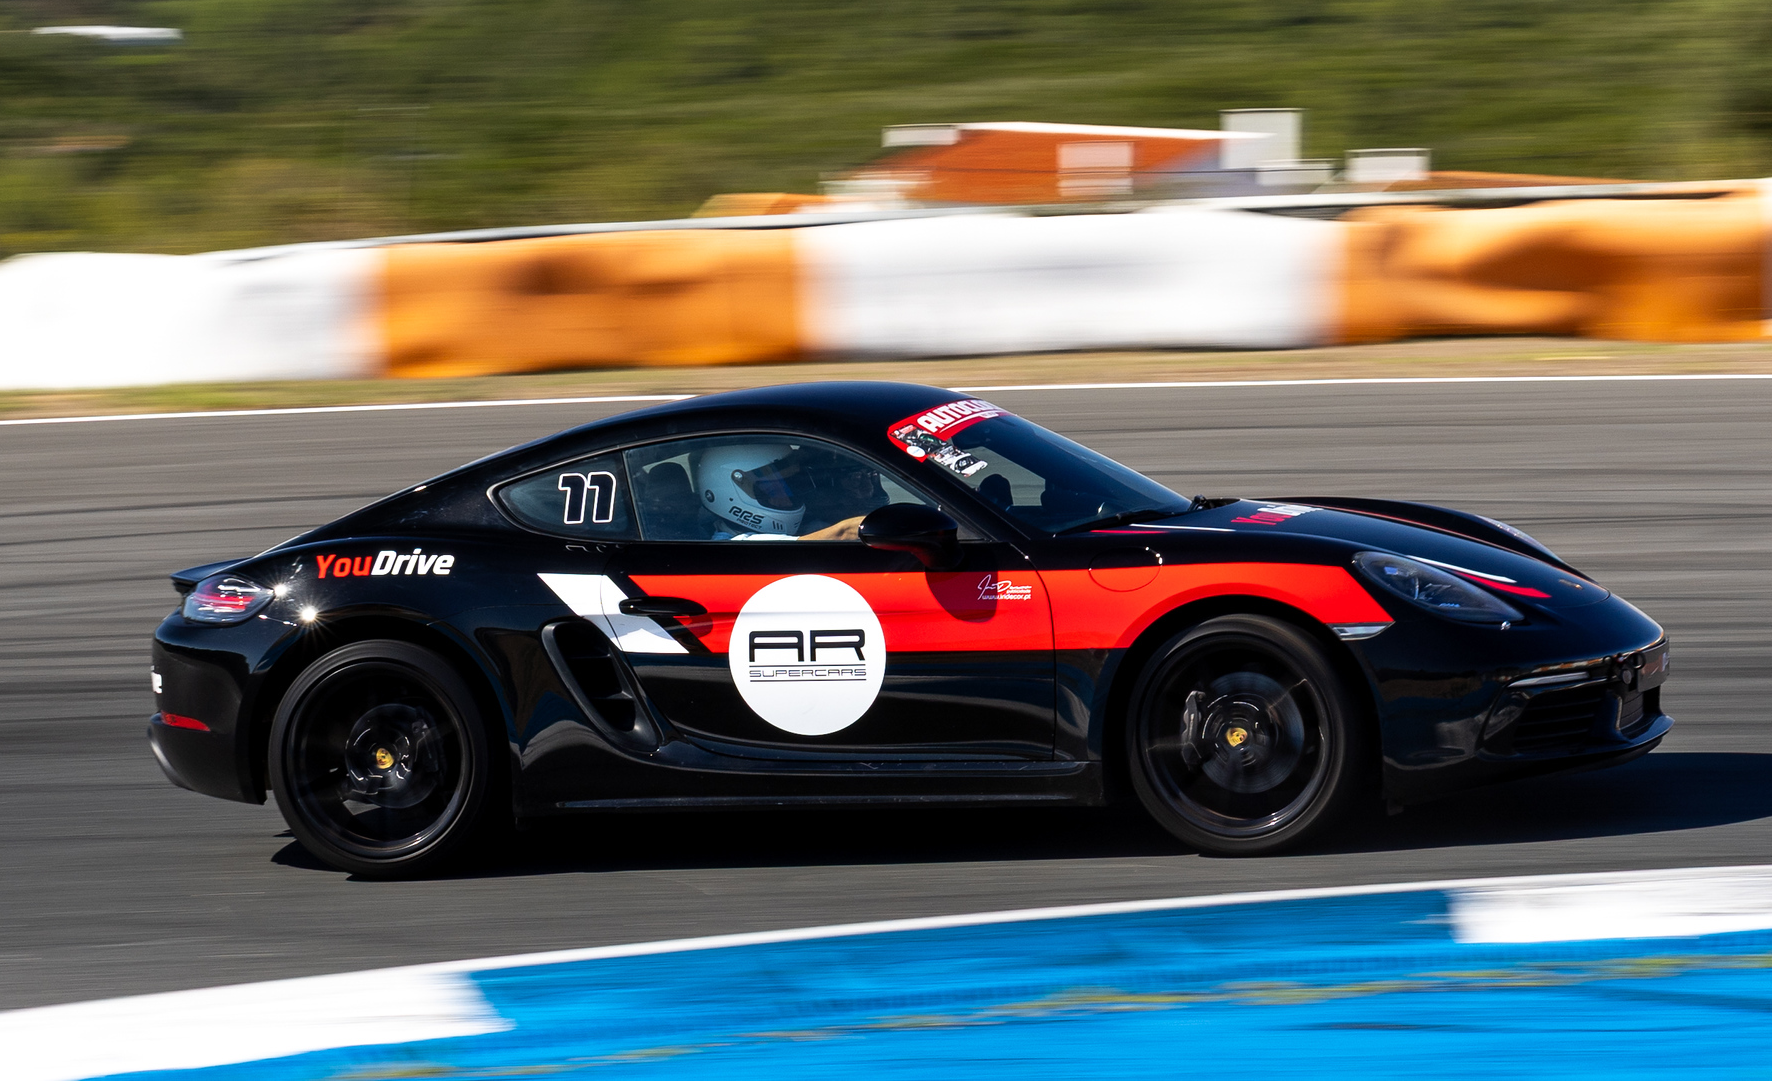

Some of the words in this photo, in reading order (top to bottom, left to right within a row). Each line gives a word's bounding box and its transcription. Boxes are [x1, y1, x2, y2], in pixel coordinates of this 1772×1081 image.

[558, 471, 617, 525] 11
[728, 505, 765, 526] RRS
[316, 548, 455, 579] YouDrive
[748, 628, 866, 663] AR
[748, 668, 867, 678] SUPERCARS
